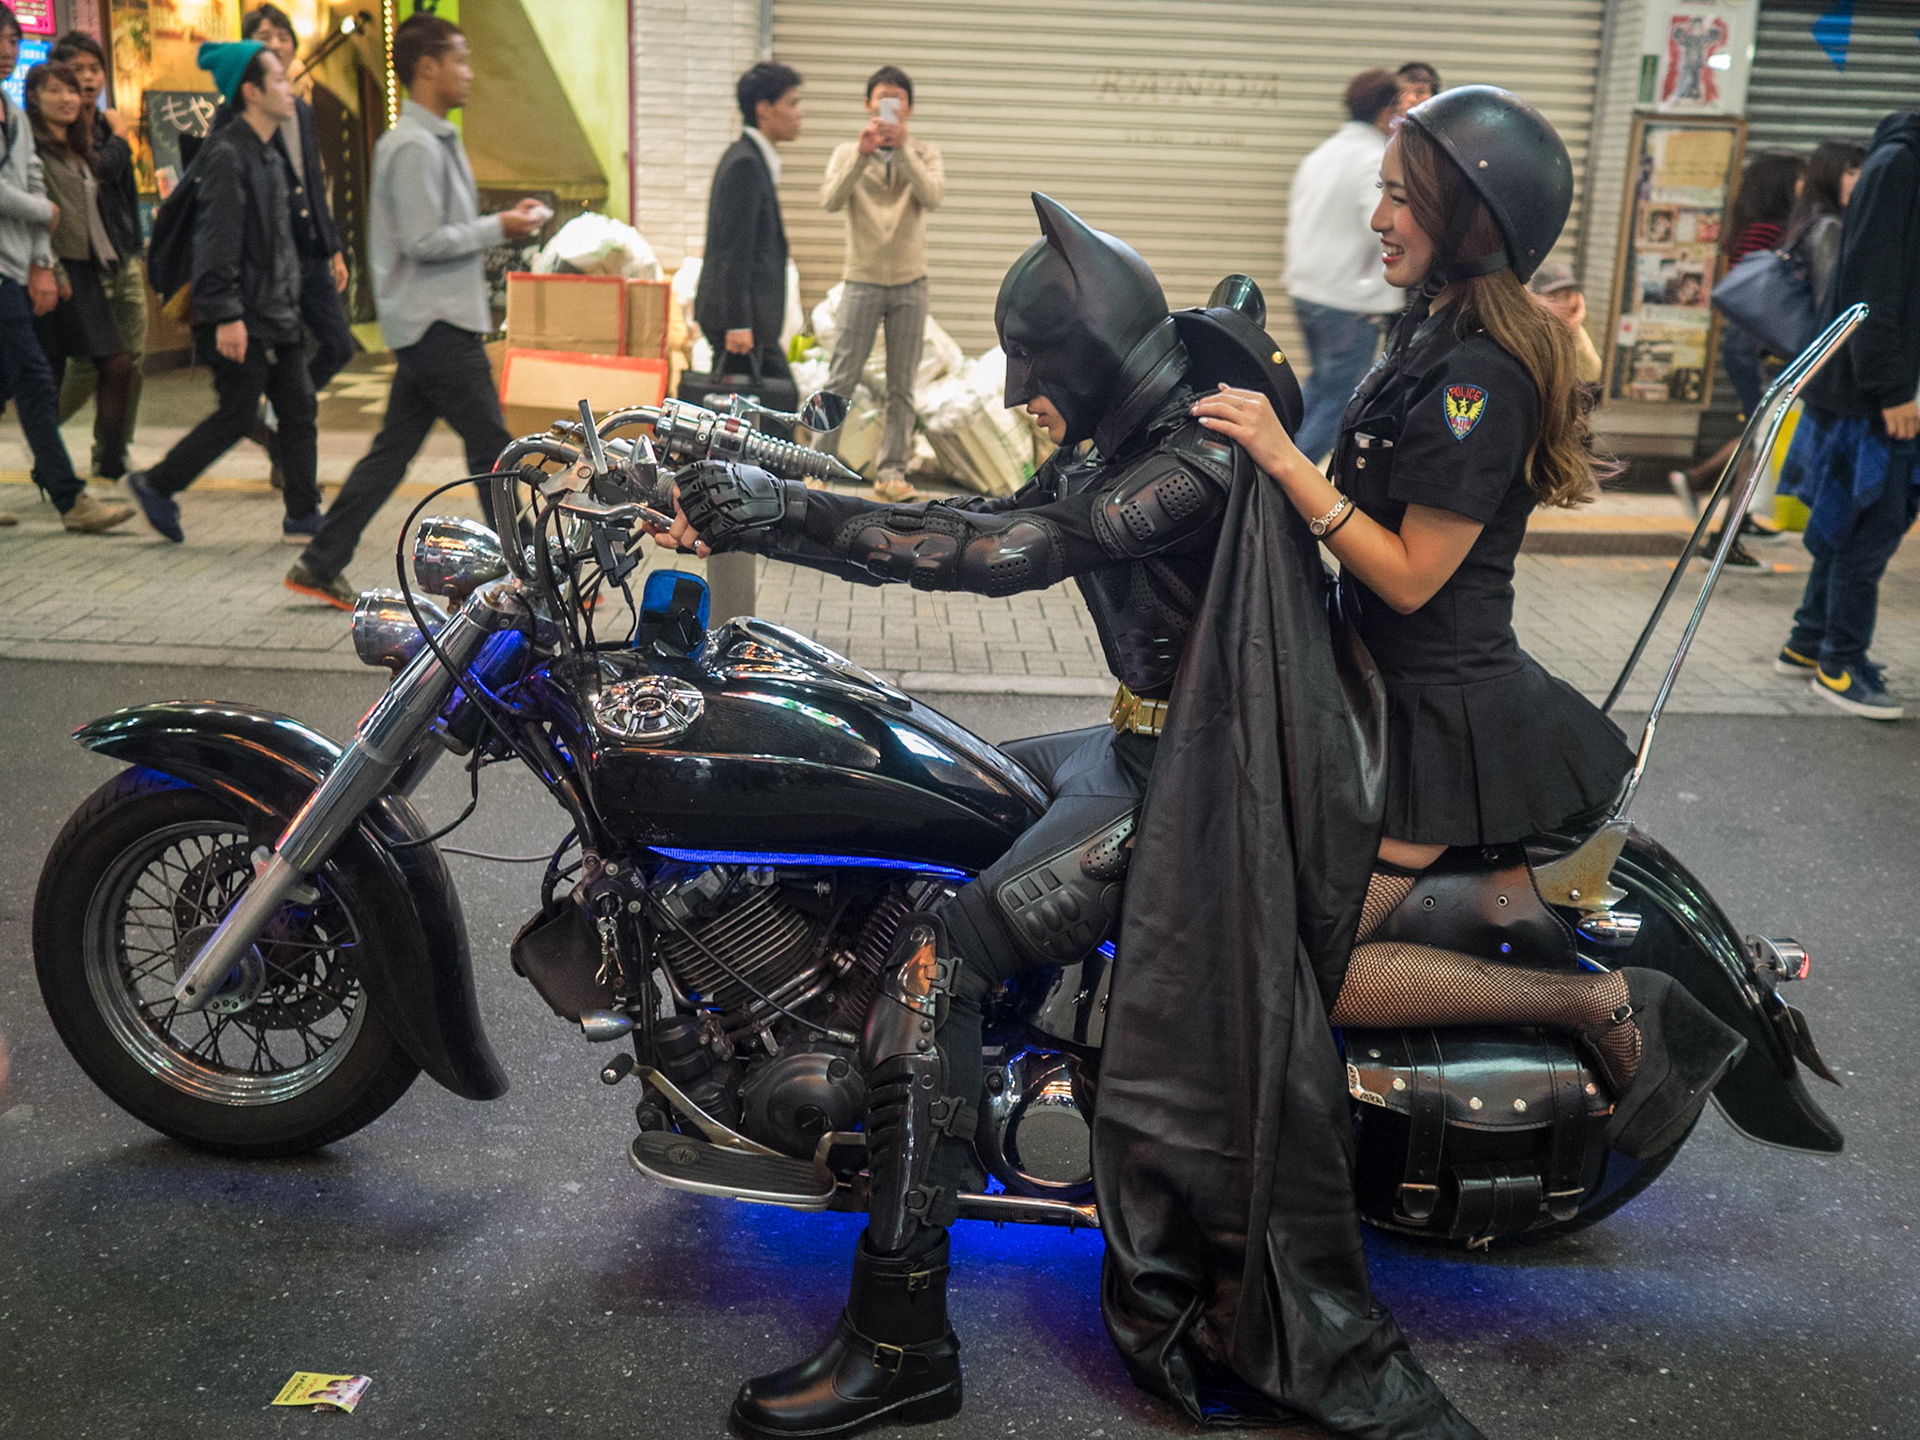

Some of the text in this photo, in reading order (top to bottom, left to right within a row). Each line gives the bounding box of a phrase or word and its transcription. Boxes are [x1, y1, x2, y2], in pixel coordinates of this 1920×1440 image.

[1091, 67, 1279, 107] RANDA
[160, 94, 225, 138] もや
[1449, 386, 1482, 401] POLICE
